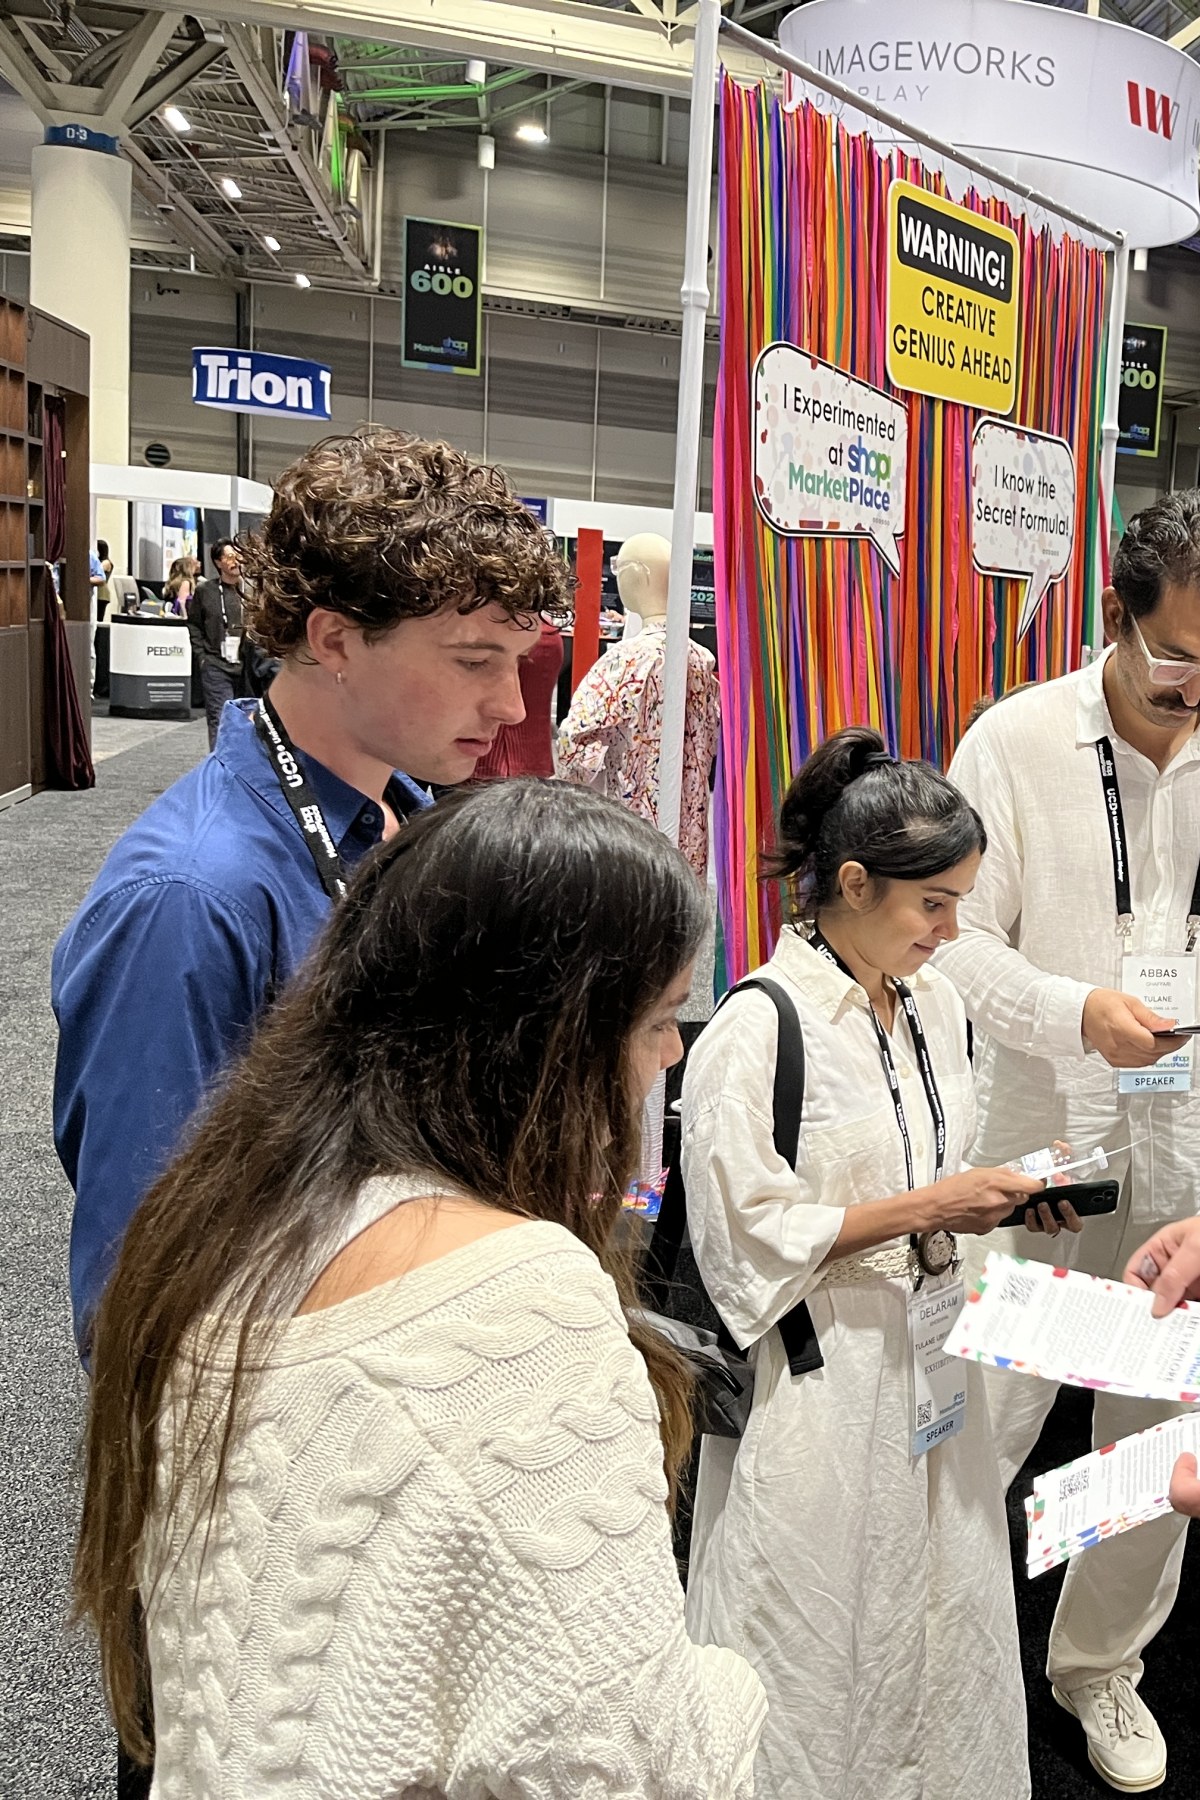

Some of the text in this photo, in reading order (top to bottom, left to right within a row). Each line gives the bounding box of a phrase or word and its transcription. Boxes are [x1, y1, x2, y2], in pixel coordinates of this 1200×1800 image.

[817, 41, 1055, 87] IMAGEWORKS
[901, 212, 1006, 290] WARNING!
[410, 269, 473, 298] 600
[922, 286, 996, 337] CREATIVE
[893, 324, 1012, 384] GENIUS AHEAD
[201, 354, 313, 410] Trion
[783, 384, 896, 442] I Experimented
[829, 435, 892, 489] at shop!
[994, 464, 1056, 499] I know the
[789, 462, 891, 512] MarketPlace
[976, 498, 1069, 536] Secret Formula!
[1140, 969, 1178, 978] ABBAS
[1135, 1077, 1175, 1086] SPEAKER
[919, 1296, 958, 1321] DELARAM
[926, 1420, 954, 1443] SPEAKER
